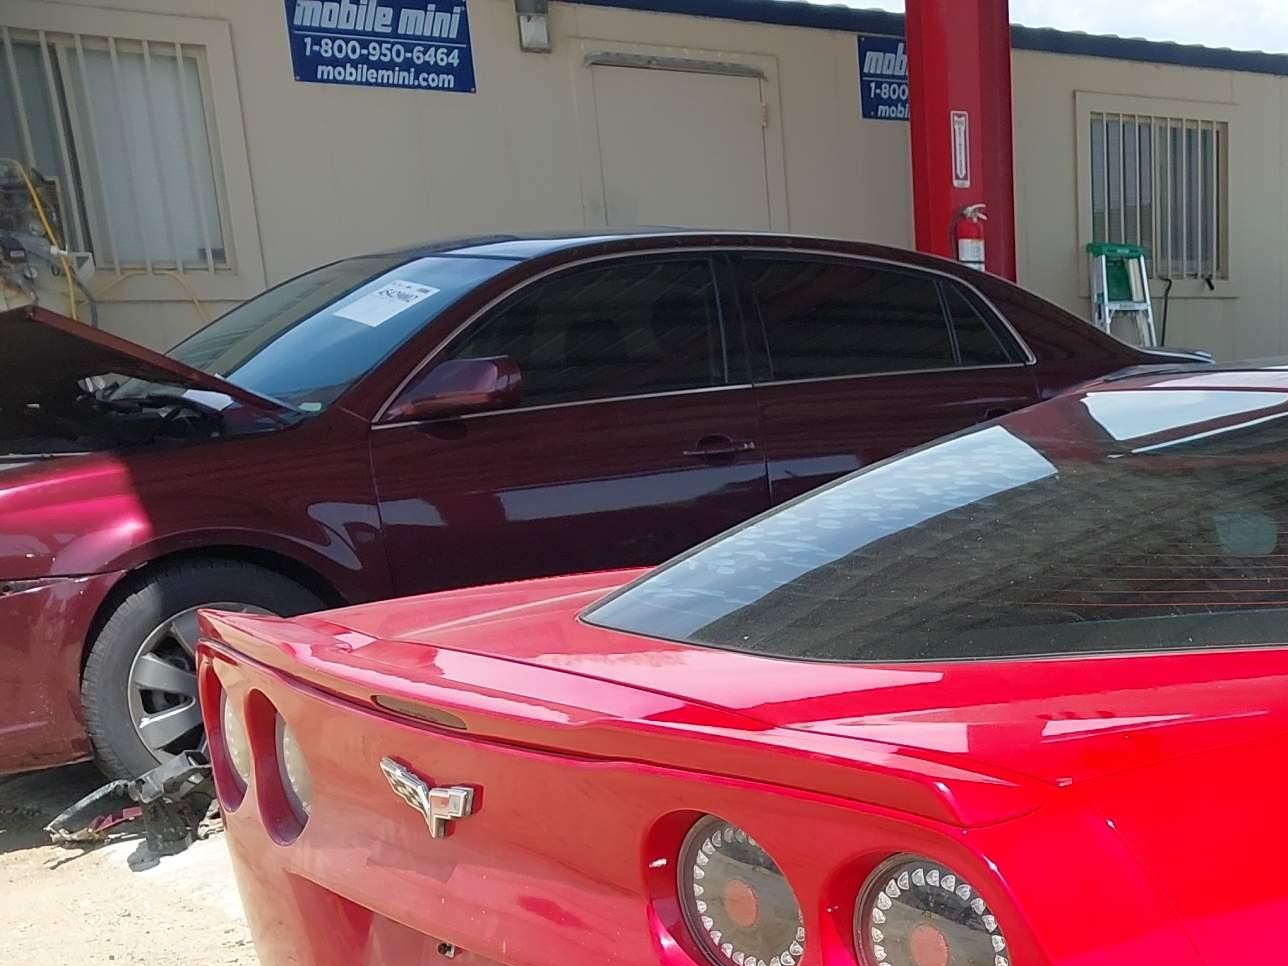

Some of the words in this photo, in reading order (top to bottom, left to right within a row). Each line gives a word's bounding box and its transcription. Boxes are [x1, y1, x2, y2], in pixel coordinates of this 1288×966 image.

[293, 0, 394, 33] mobile
[397, 4, 462, 38] mini
[303, 37, 460, 67] 1-800-950-6464
[863, 43, 909, 76] mob
[317, 63, 455, 88] mobilemini.com
[877, 103, 911, 118] mobi
